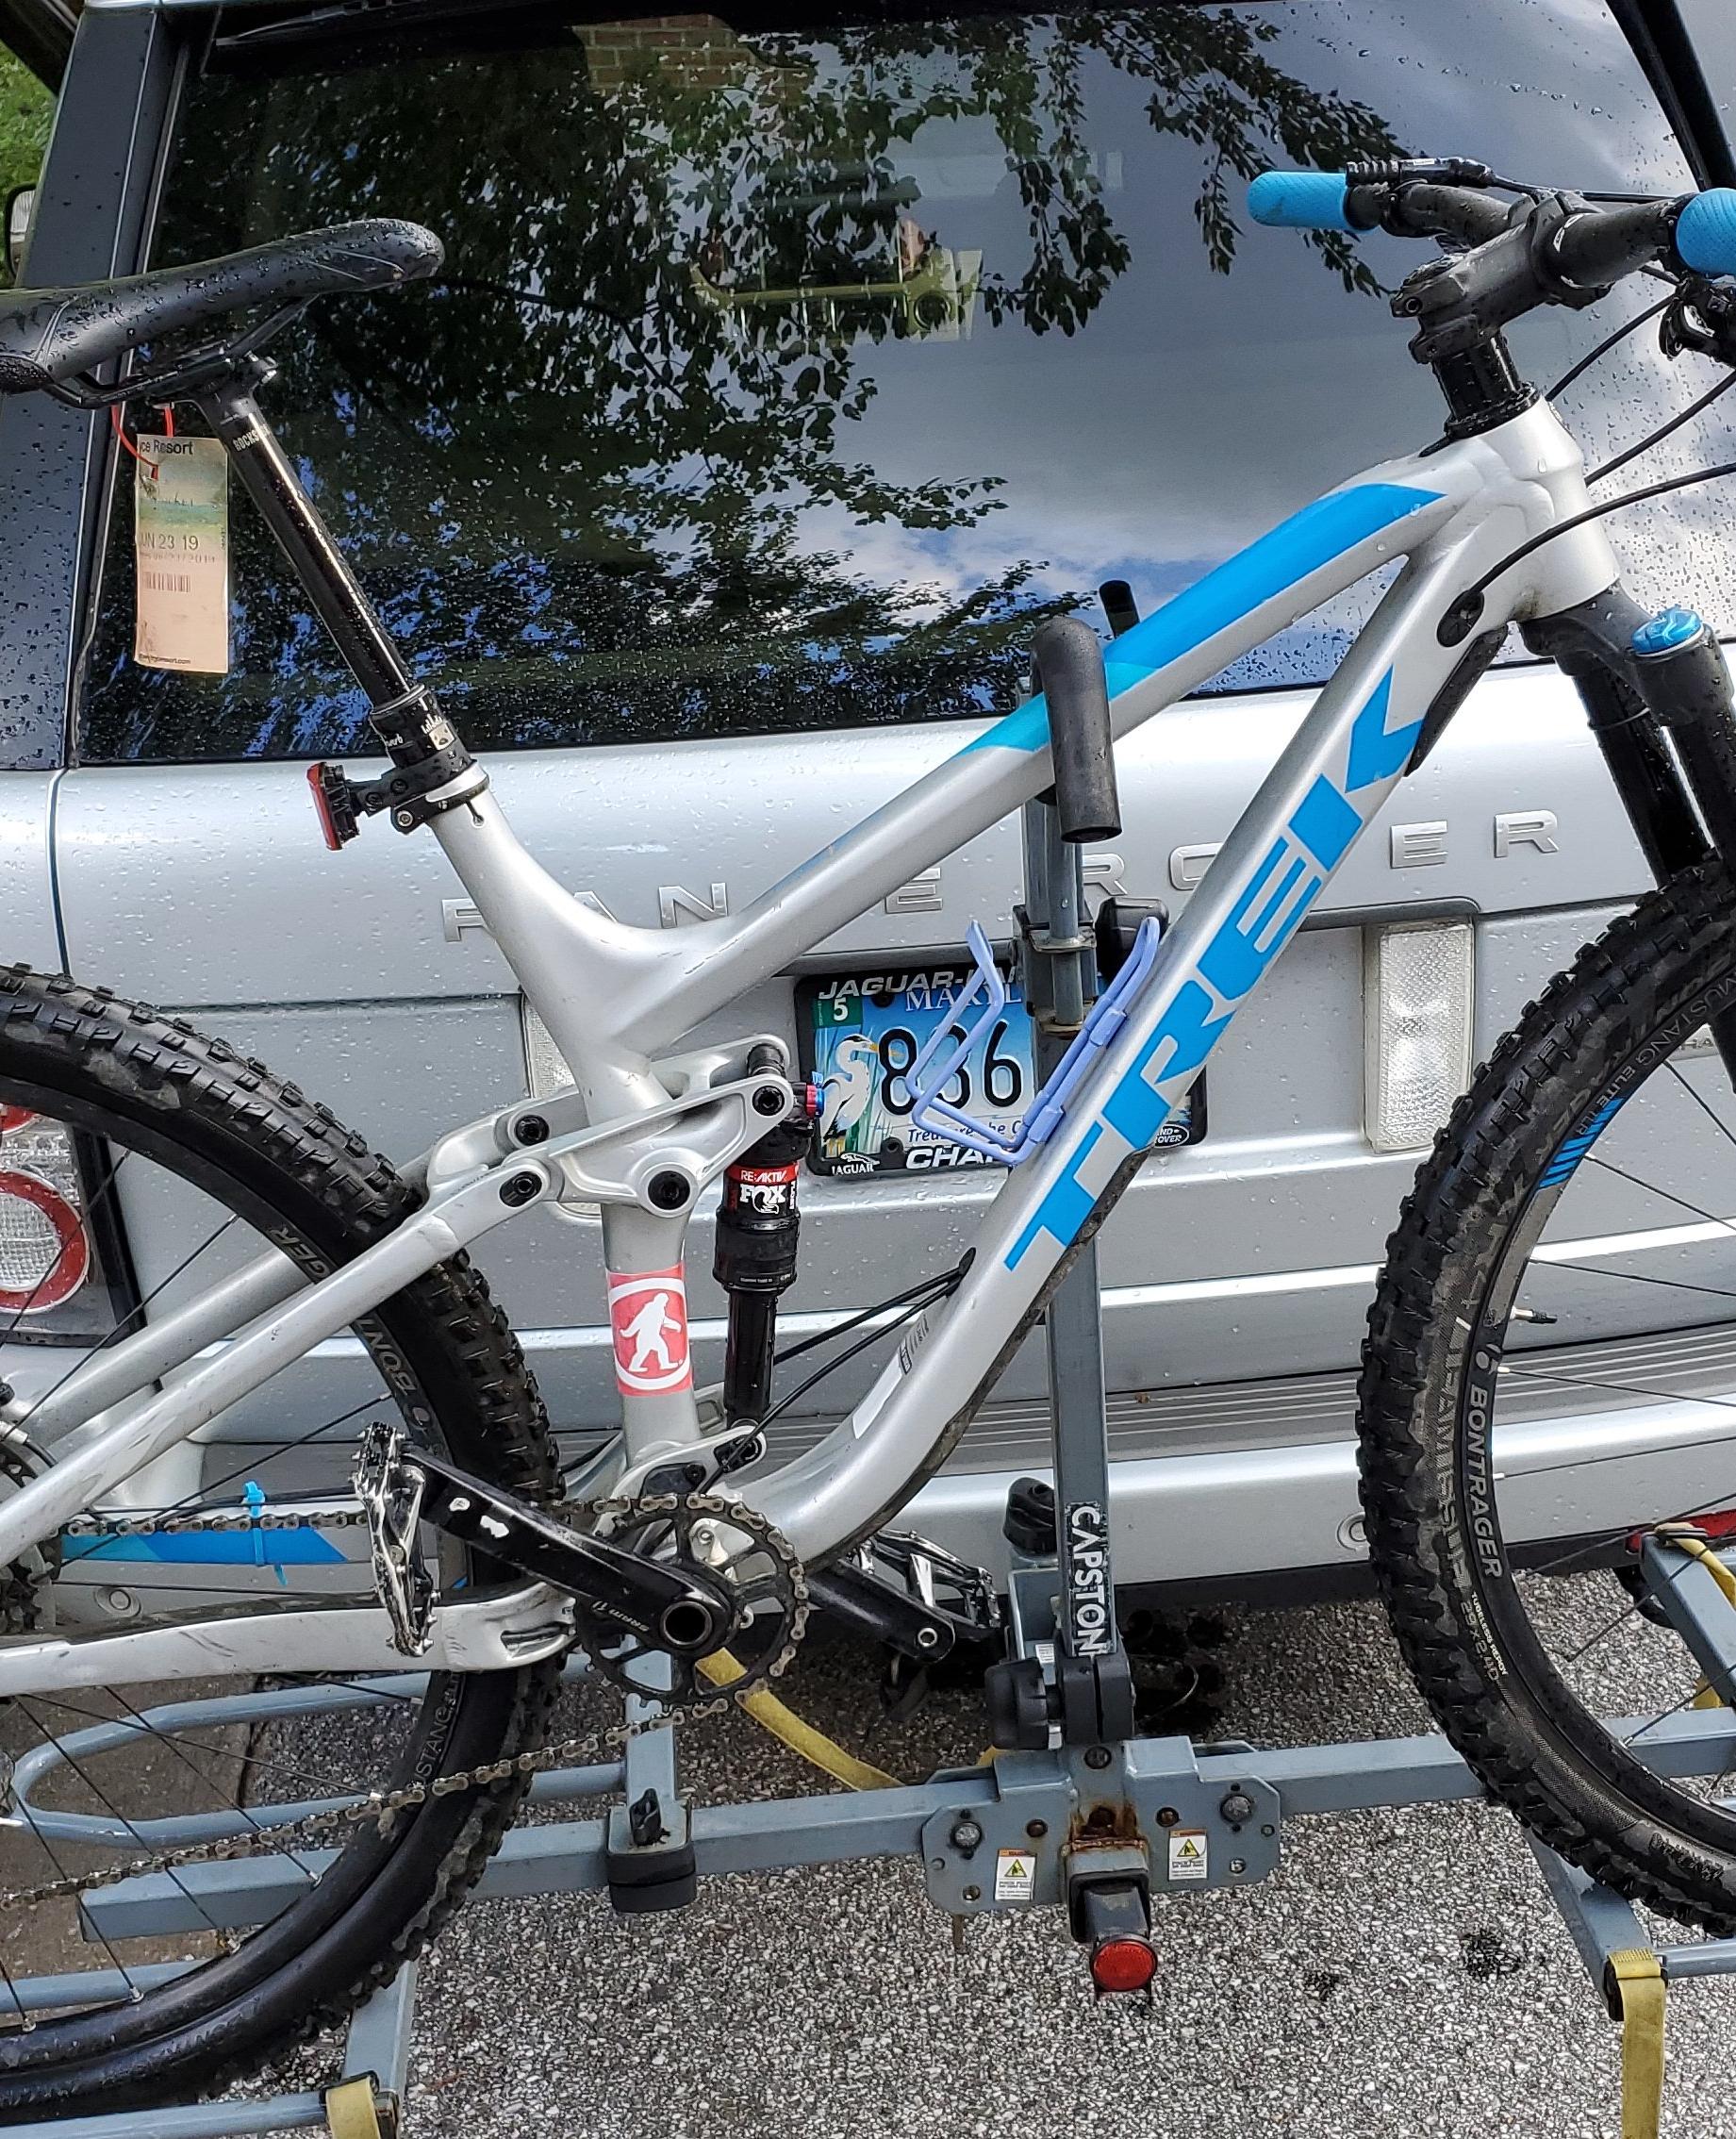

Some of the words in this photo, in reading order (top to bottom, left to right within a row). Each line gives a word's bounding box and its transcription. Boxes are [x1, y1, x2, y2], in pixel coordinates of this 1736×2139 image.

[154, 439, 193, 455] Resort
[158, 535, 174, 550] 23
[182, 534, 199, 551] 19
[1004, 664, 1426, 1271] TREK
[833, 997, 849, 1021] 5
[1595, 1065, 1636, 1109] ELITE
[1156, 1135, 1182, 1144] OVER
[831, 1163, 875, 1176] JAGUAR
[739, 1183, 786, 1214] FOX
[1465, 1384, 1504, 1579] BONTRAGER
